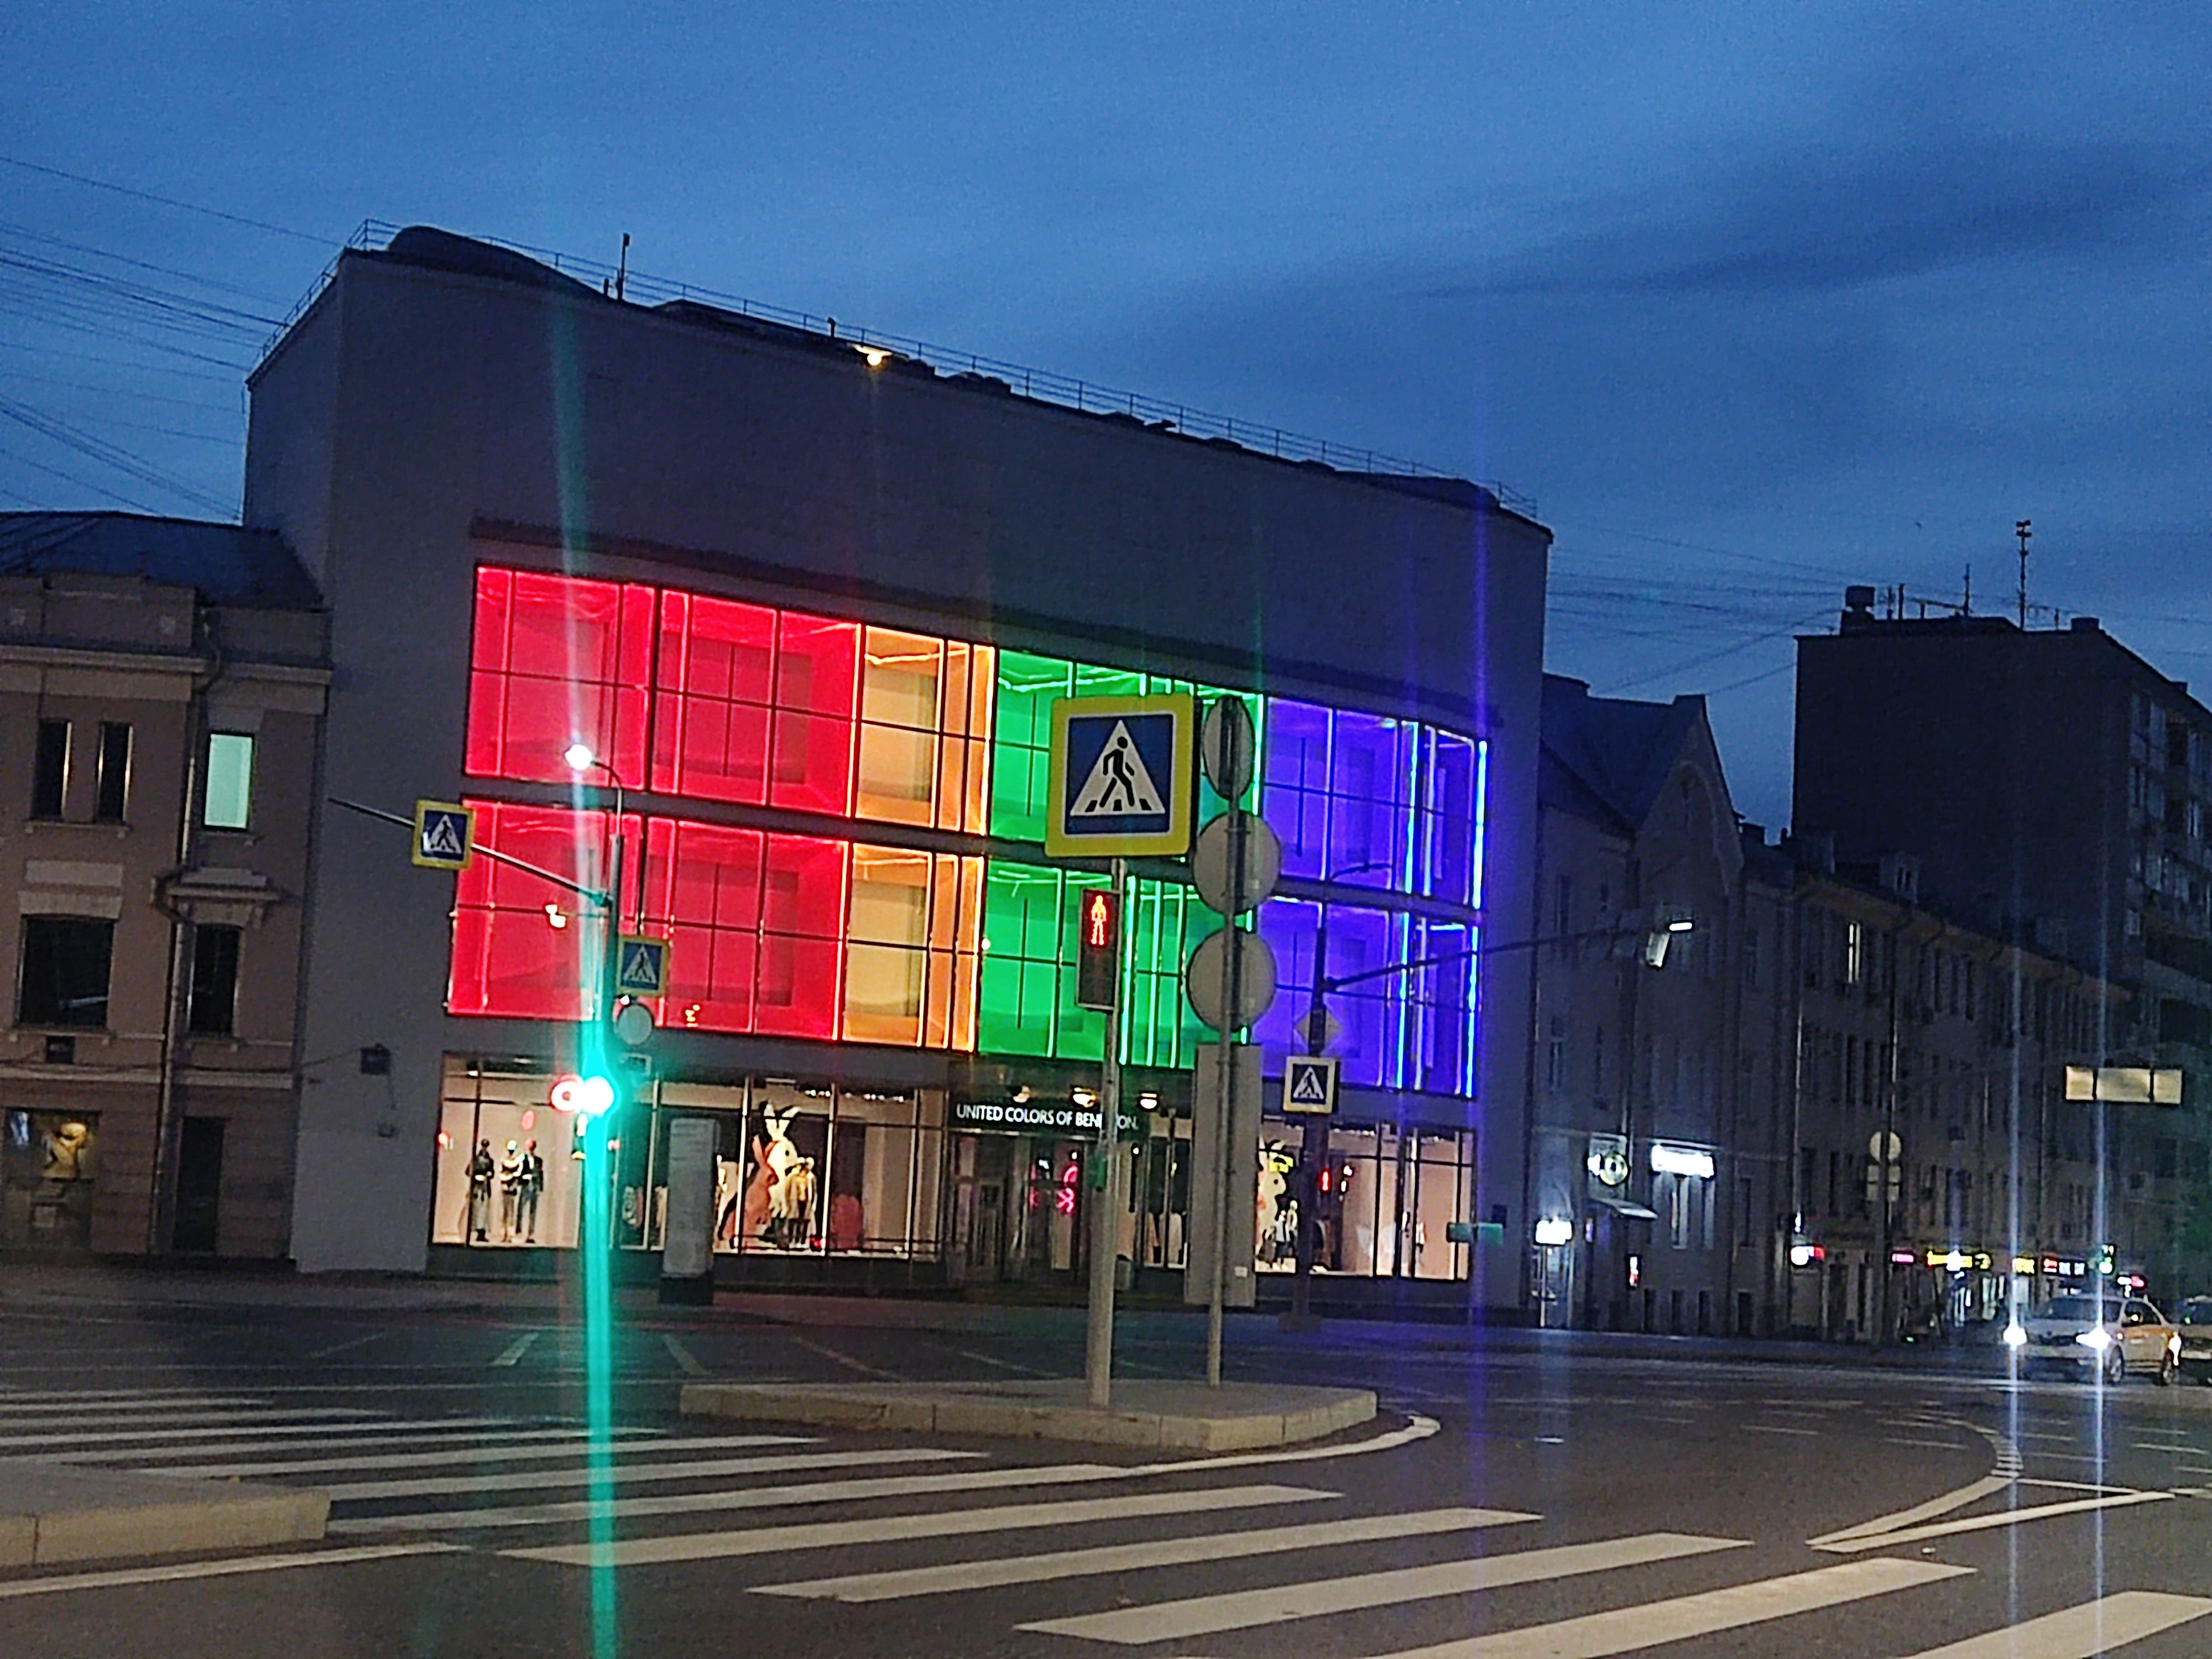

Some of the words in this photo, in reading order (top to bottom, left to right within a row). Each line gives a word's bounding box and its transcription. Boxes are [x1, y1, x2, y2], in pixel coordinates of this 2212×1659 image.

[956, 1104, 1003, 1121] UNITED
[1005, 1107, 1054, 1125] COLORS
[1056, 1110, 1073, 1126] OF
